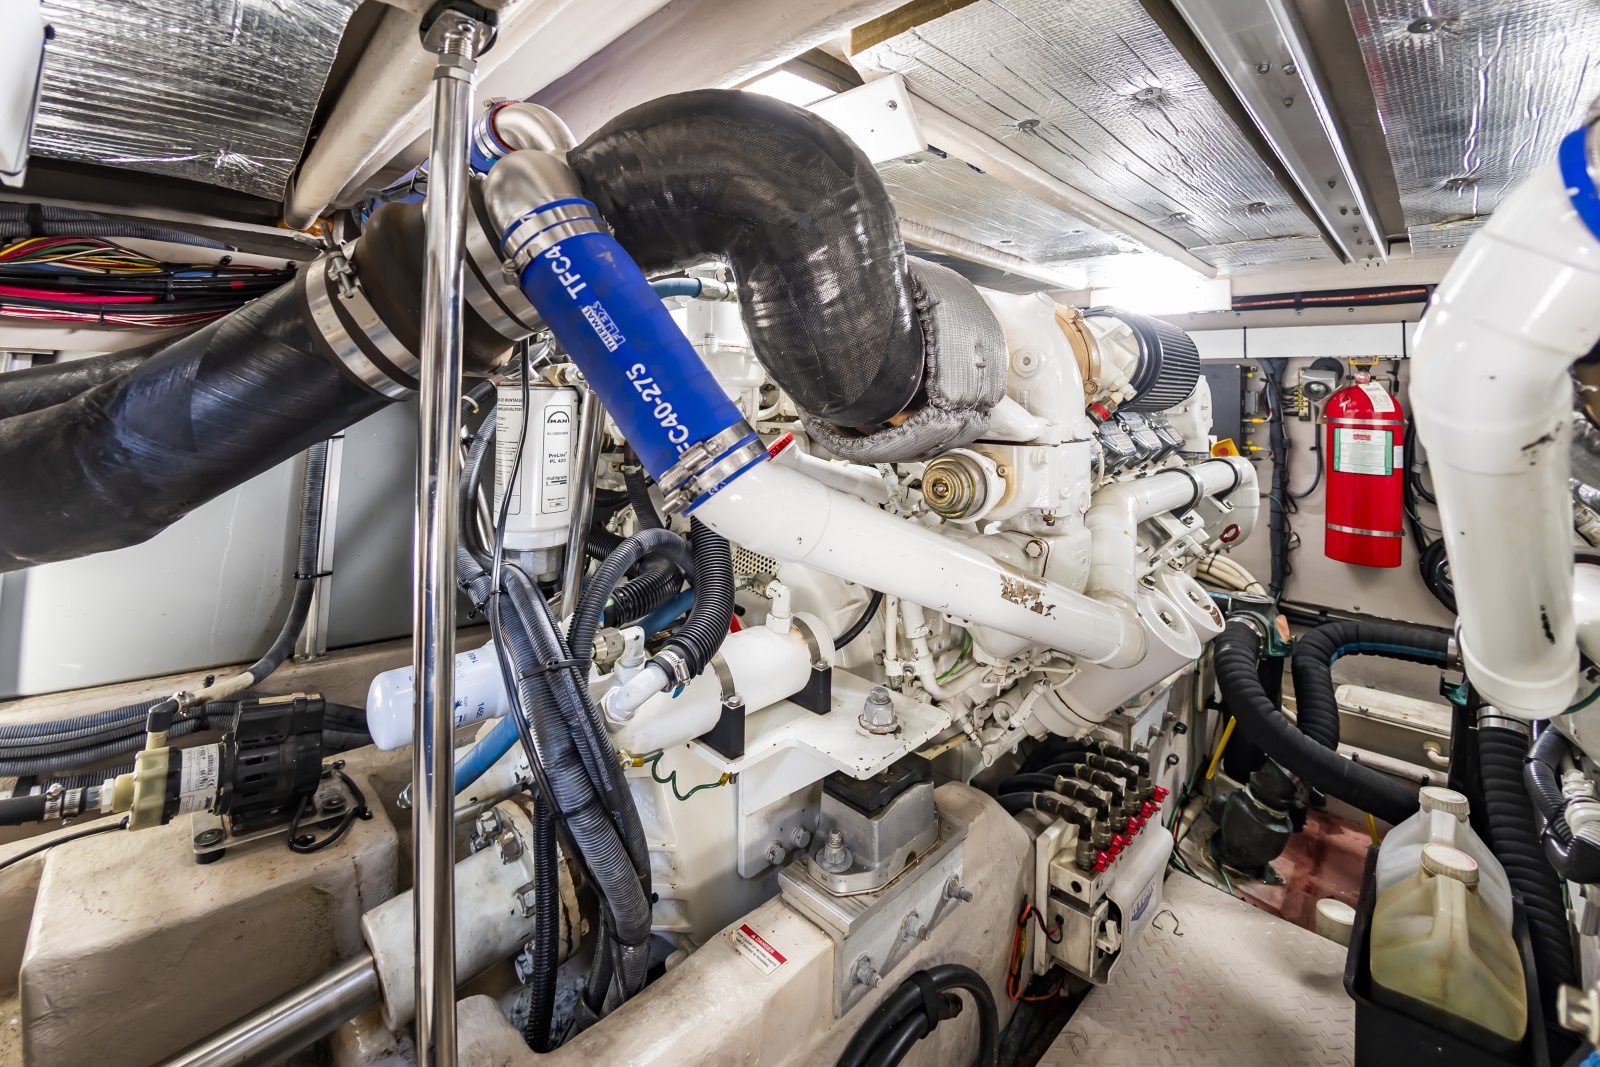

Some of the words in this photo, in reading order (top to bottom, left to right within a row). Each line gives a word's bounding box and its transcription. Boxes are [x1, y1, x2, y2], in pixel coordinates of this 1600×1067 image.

[581, 305, 619, 352] THERMAL
[592, 300, 626, 346] FLEX
[564, 674, 574, 692] USCG
[571, 692, 582, 709] J1527
[577, 707, 586, 721] SAE
[583, 720, 594, 737] FUEL
[588, 735, 602, 758] MARINE
[754, 936, 774, 953] DANGER
